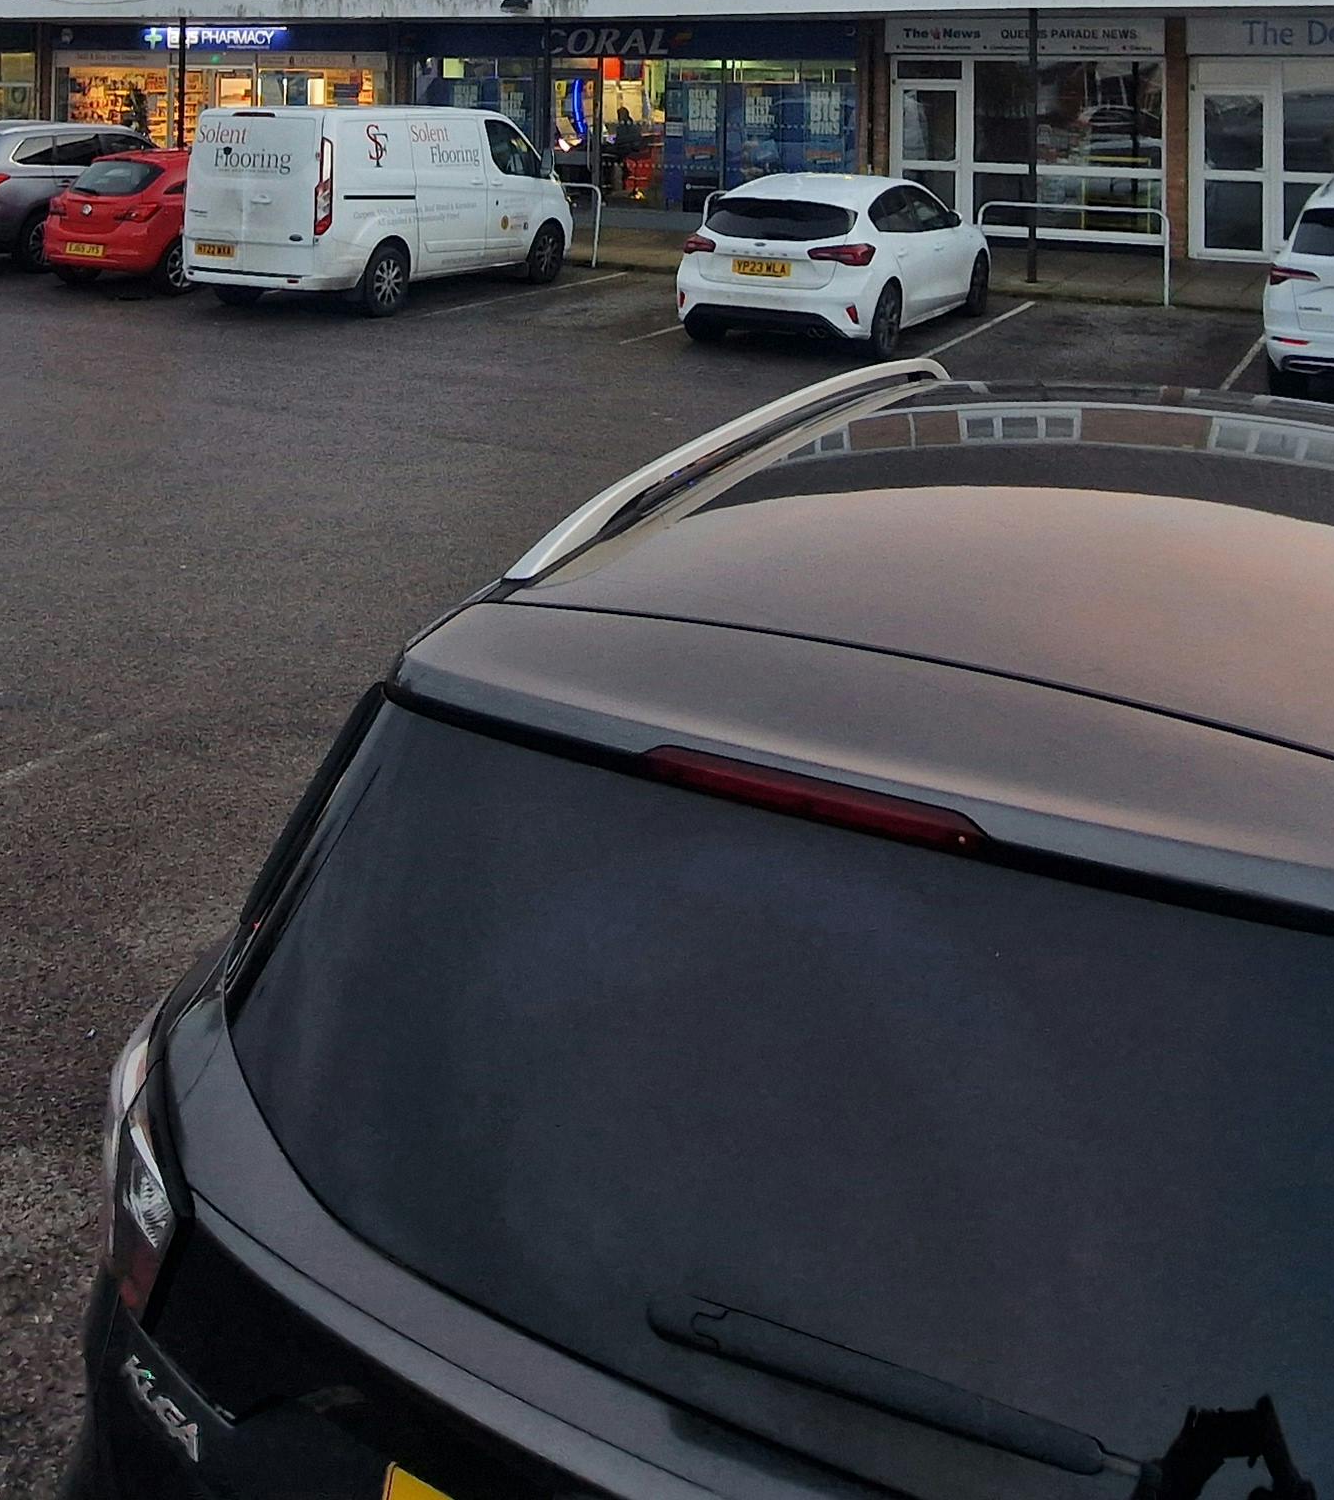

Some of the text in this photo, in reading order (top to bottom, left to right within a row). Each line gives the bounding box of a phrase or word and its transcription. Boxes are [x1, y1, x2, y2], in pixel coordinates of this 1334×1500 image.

[202, 29, 275, 45] PHARMACY
[542, 28, 668, 55] CORAL
[903, 28, 982, 39] The News
[1051, 29, 1098, 39] PARADE
[1102, 29, 1138, 39] NEWS
[1243, 20, 1294, 45] The
[689, 100, 717, 118] BIG
[810, 101, 840, 121] BIG
[198, 122, 247, 145] Solent
[410, 122, 449, 142] Solent
[689, 119, 716, 131] WINS
[810, 122, 840, 134] WINS
[214, 147, 292, 175] Flooring
[431, 145, 479, 167] Flooring
[737, 260, 786, 275] YP23 WLA
[124, 1354, 199, 1462] KUGA
